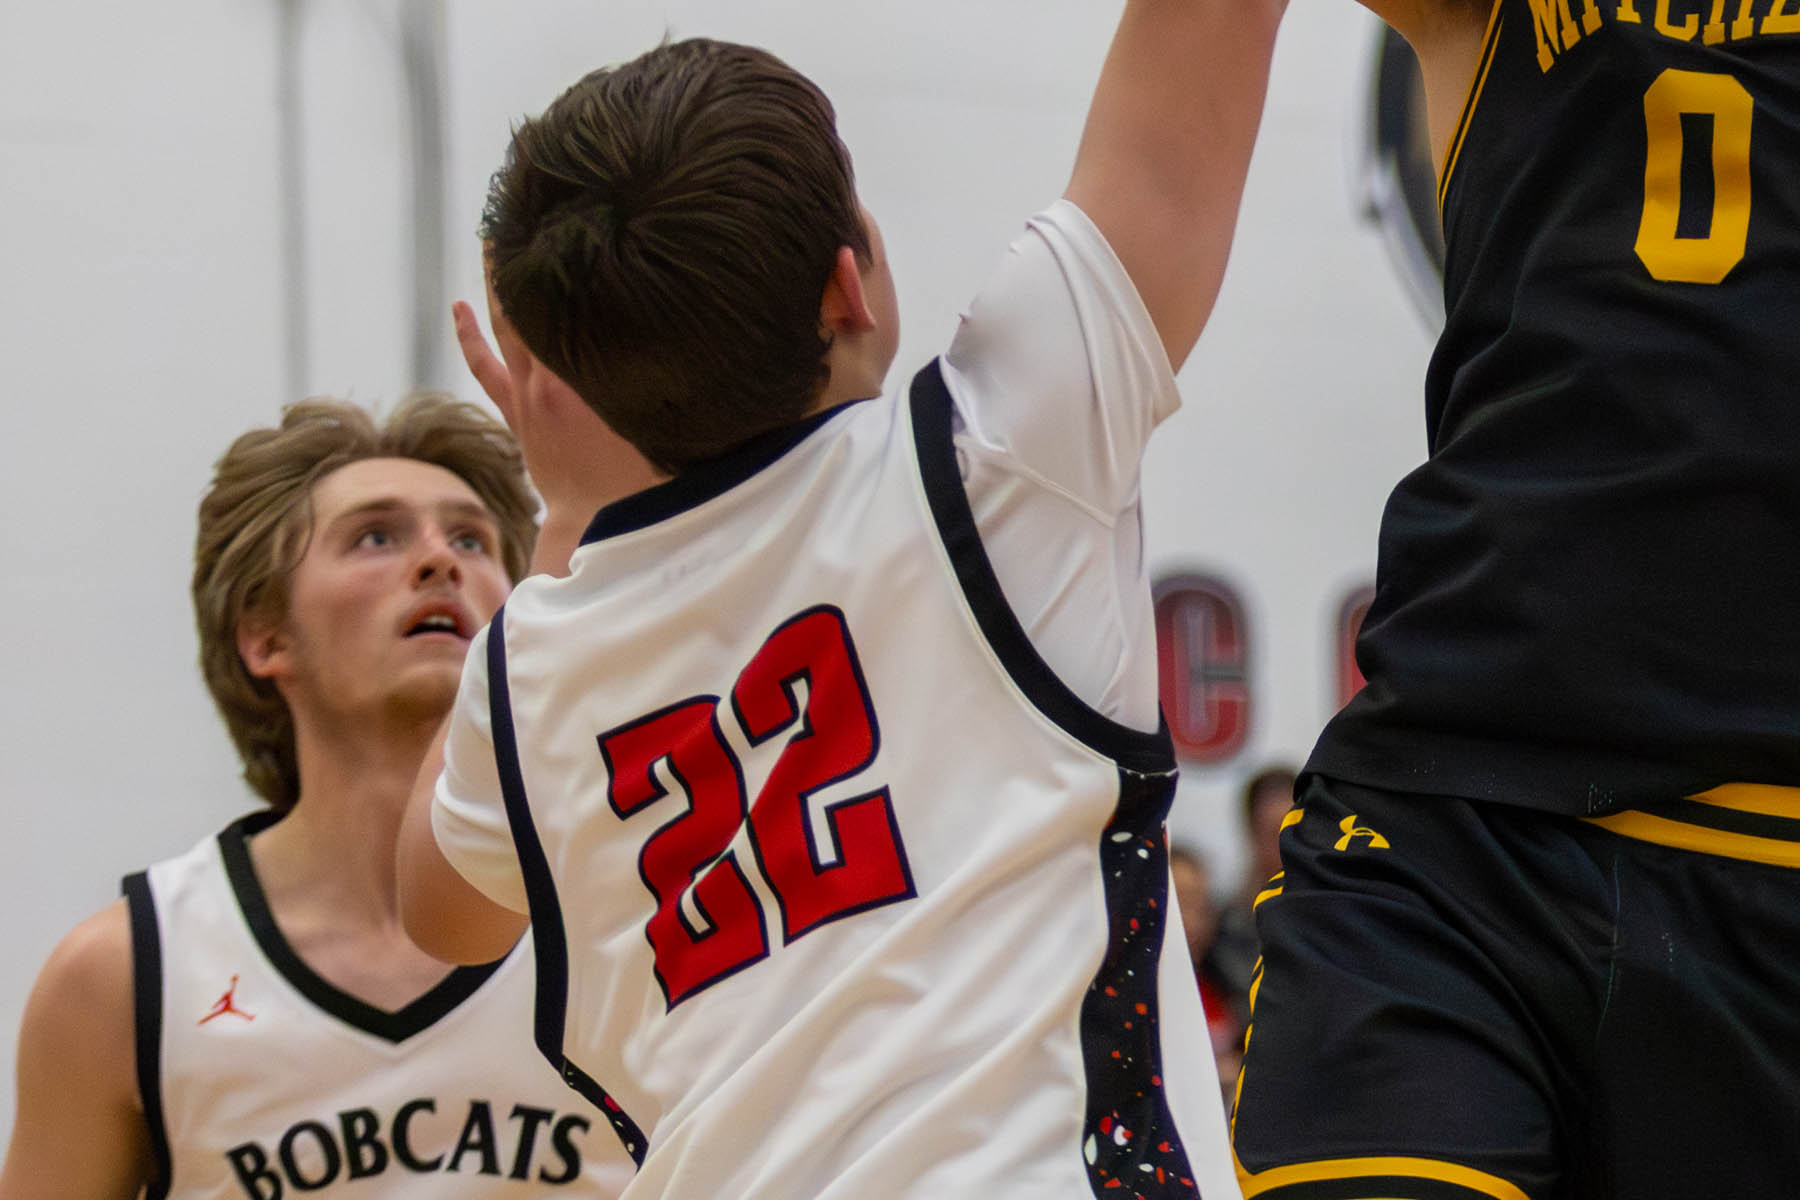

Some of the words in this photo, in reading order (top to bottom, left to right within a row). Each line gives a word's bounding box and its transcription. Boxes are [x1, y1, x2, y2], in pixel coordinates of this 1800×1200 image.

[1634, 68, 1754, 285] 0
[596, 603, 919, 1016] 22
[225, 1097, 591, 1200] BOBCATS
